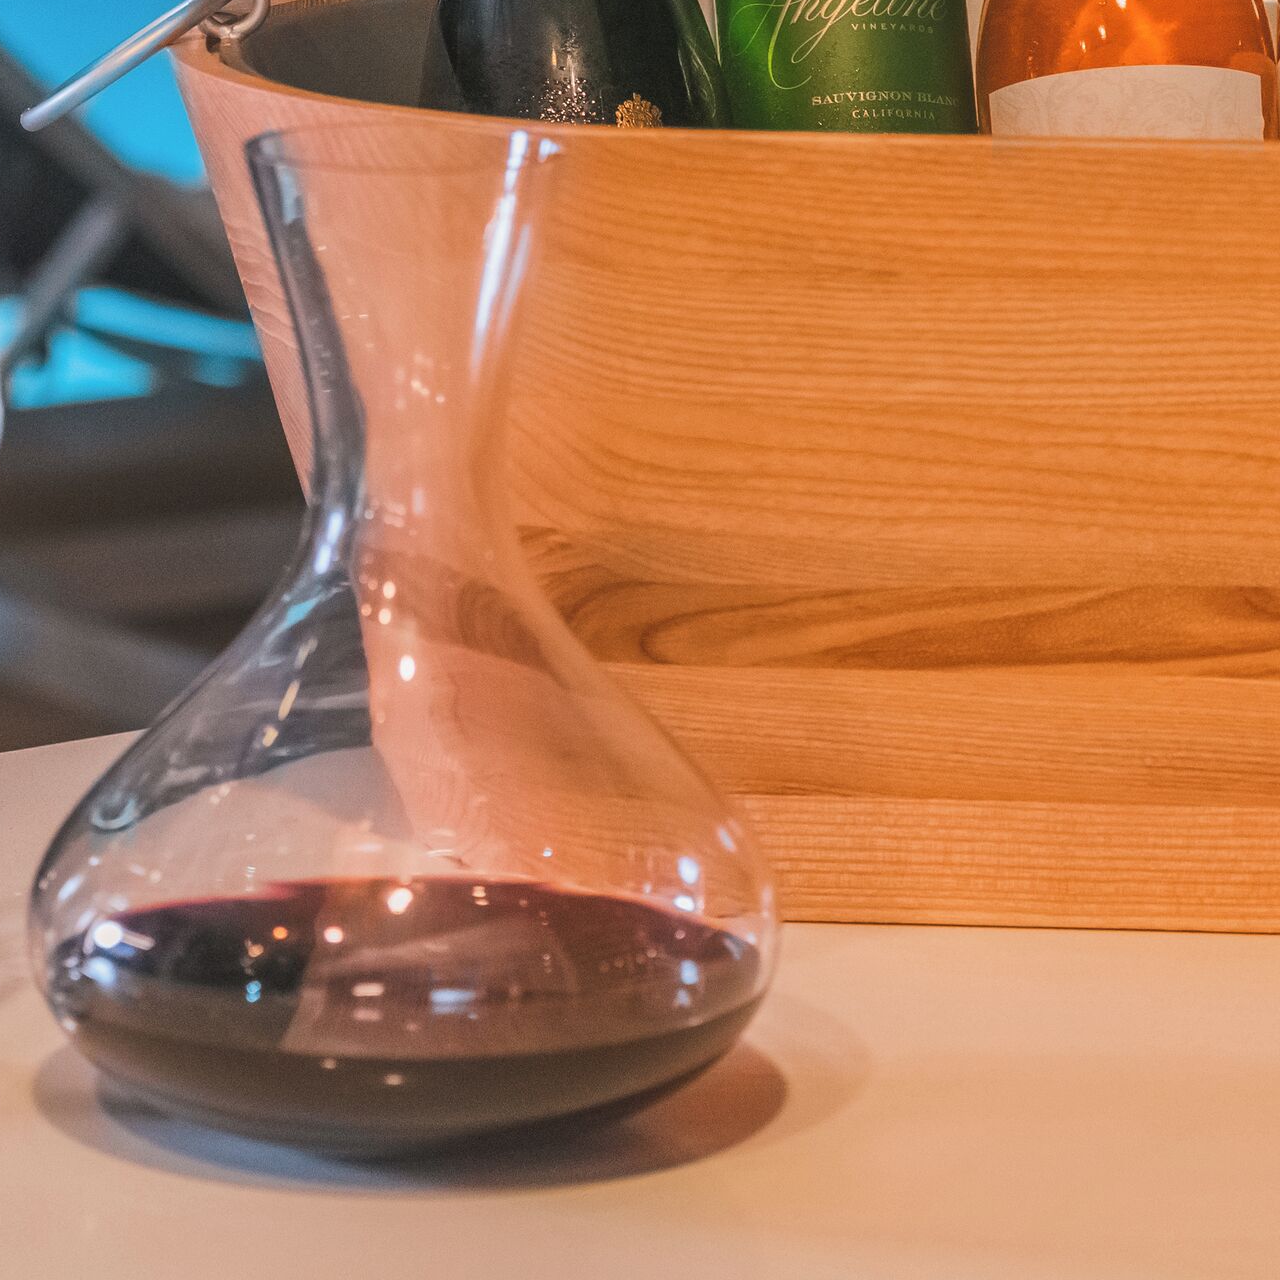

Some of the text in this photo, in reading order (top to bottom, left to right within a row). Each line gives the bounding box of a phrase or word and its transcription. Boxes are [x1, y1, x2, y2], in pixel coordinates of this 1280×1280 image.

[851, 22, 934, 34] VINEYARDS
[812, 90, 913, 106] SAUVIGNON
[851, 109, 936, 120] CALIFORNIA
